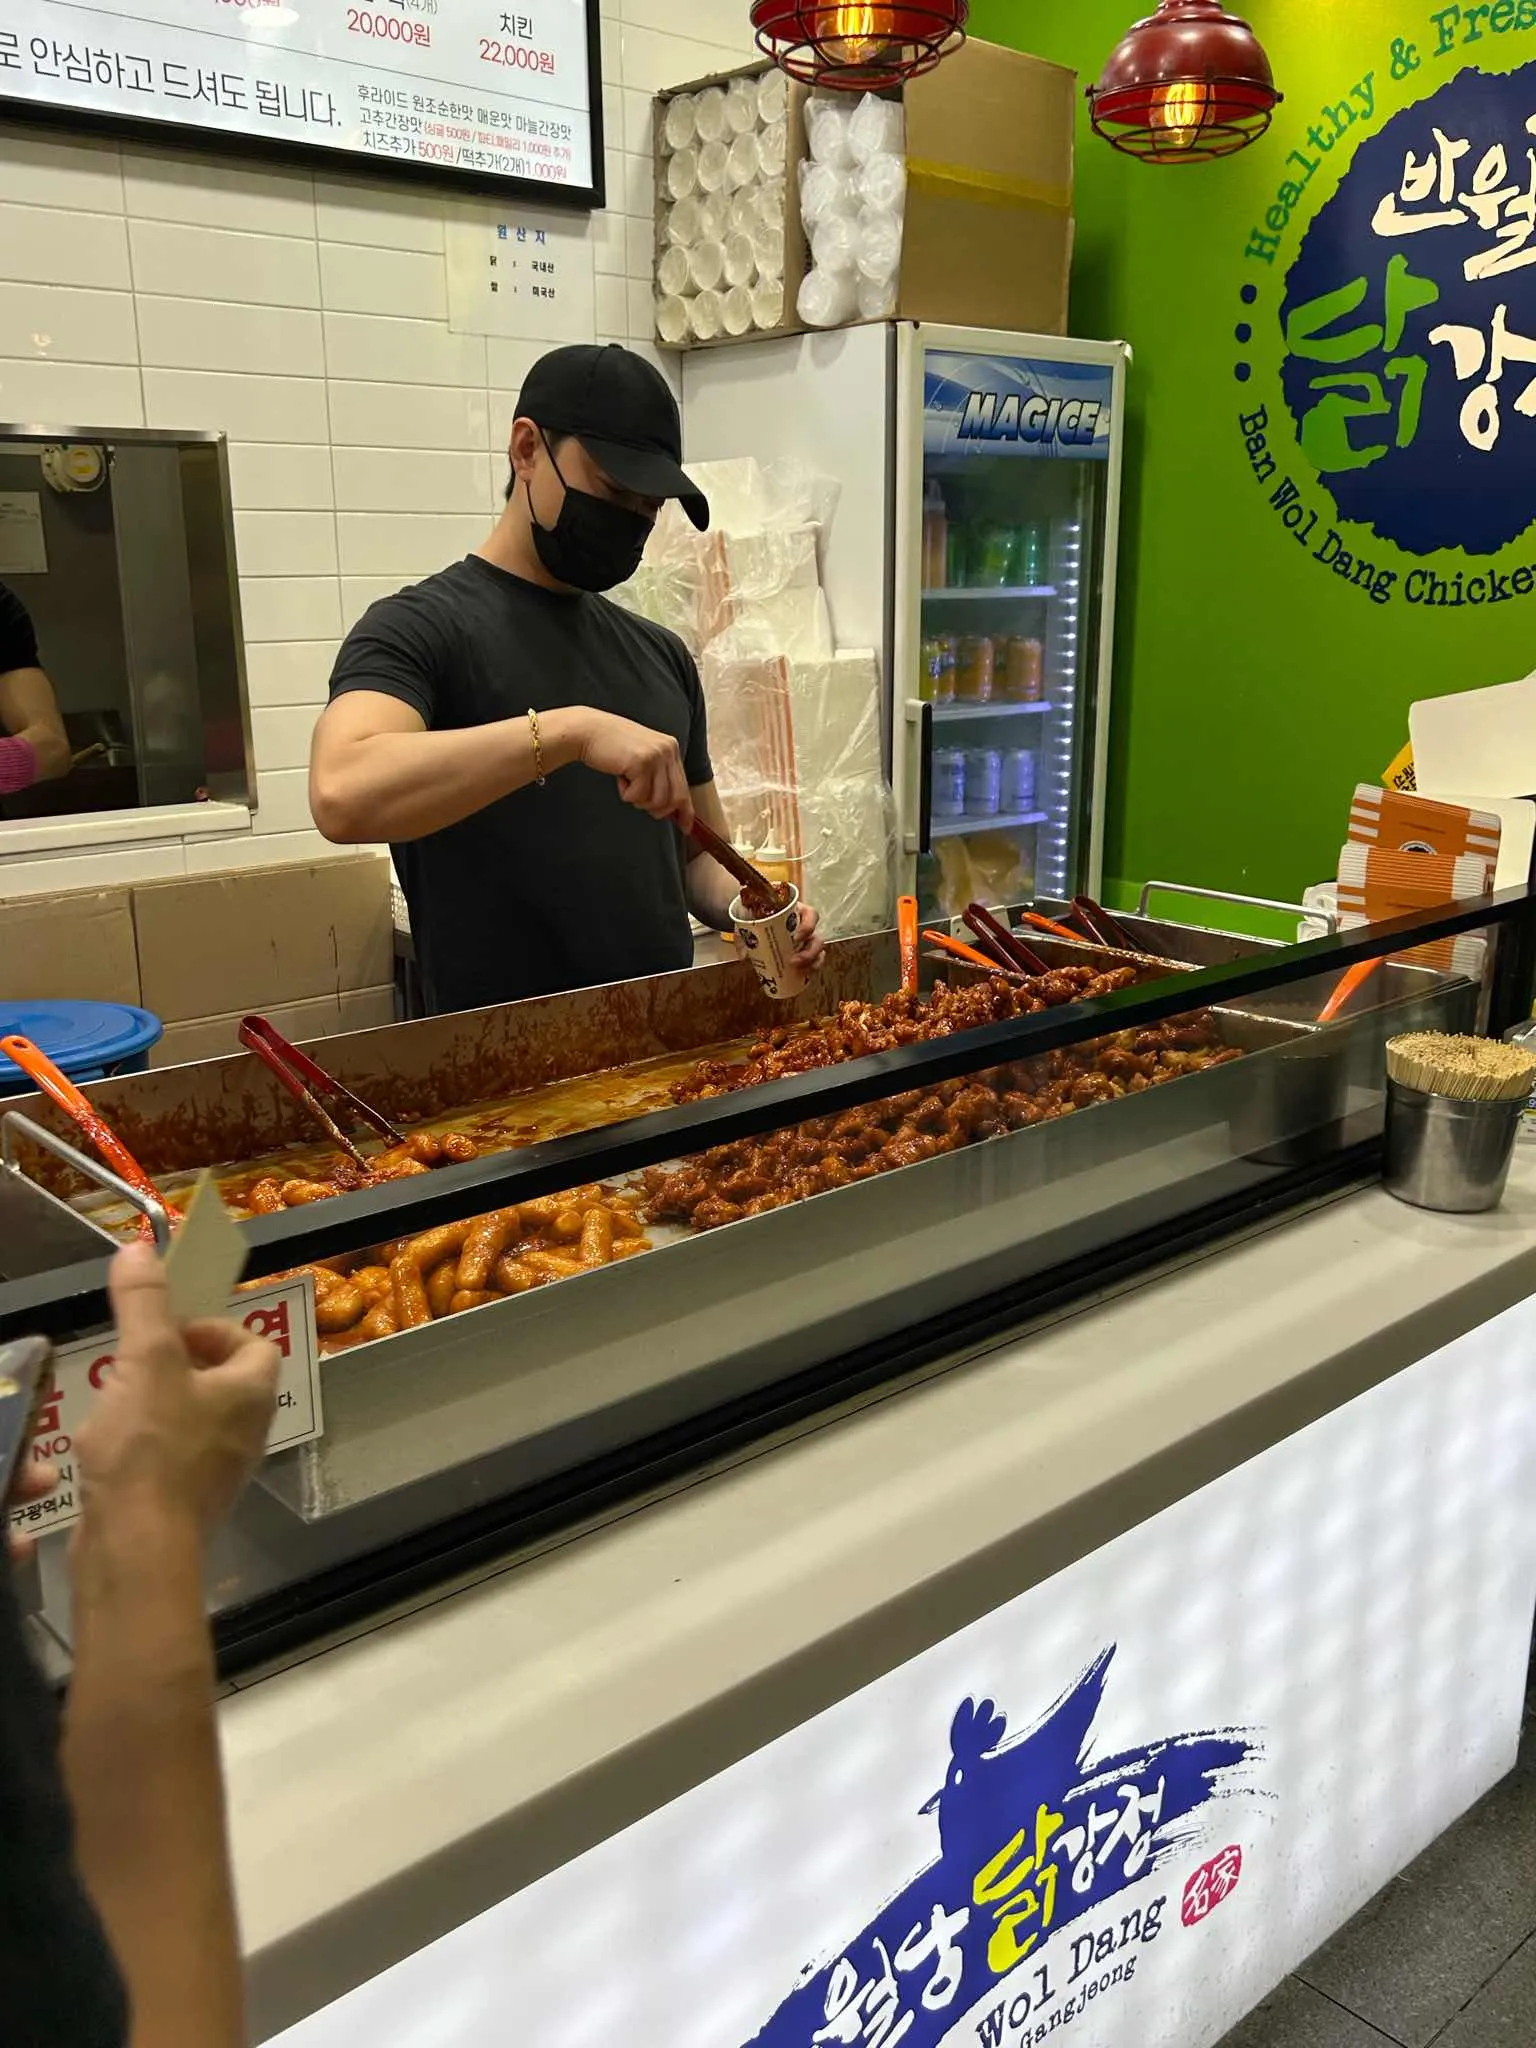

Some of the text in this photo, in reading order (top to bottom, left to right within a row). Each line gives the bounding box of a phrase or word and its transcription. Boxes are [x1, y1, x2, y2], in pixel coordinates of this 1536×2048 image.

[347, 9, 431, 48] 20,000원
[500, 12, 533, 40] 치킨
[29, 37, 155, 93] 안심하고
[162, 62, 249, 110] 드셔도
[255, 80, 342, 127] 됩니다.
[479, 38, 555, 75] 22,000원
[358, 84, 572, 141] 후라이드 원조순한맛 매운맛 마늘간장맛
[359, 108, 423, 134] 고추간장맛
[363, 131, 416, 156] 치즈추가
[418, 142, 454, 164] 500원
[1245, 71, 1374, 266] Healthy
[1391, 38, 1421, 80] &
[1371, 112, 1536, 282] 반월
[957, 391, 1101, 446] MAGICE
[1239, 403, 1536, 607] Ban Wol Dang Chicke
[33, 1435, 71, 1462] NO
[11, 1492, 74, 1526] 구광역시
[811, 1903, 970, 2048] 월당
[974, 1895, 1167, 2048] Wol Dang
[1020, 1954, 1137, 2048] Gangjeong
